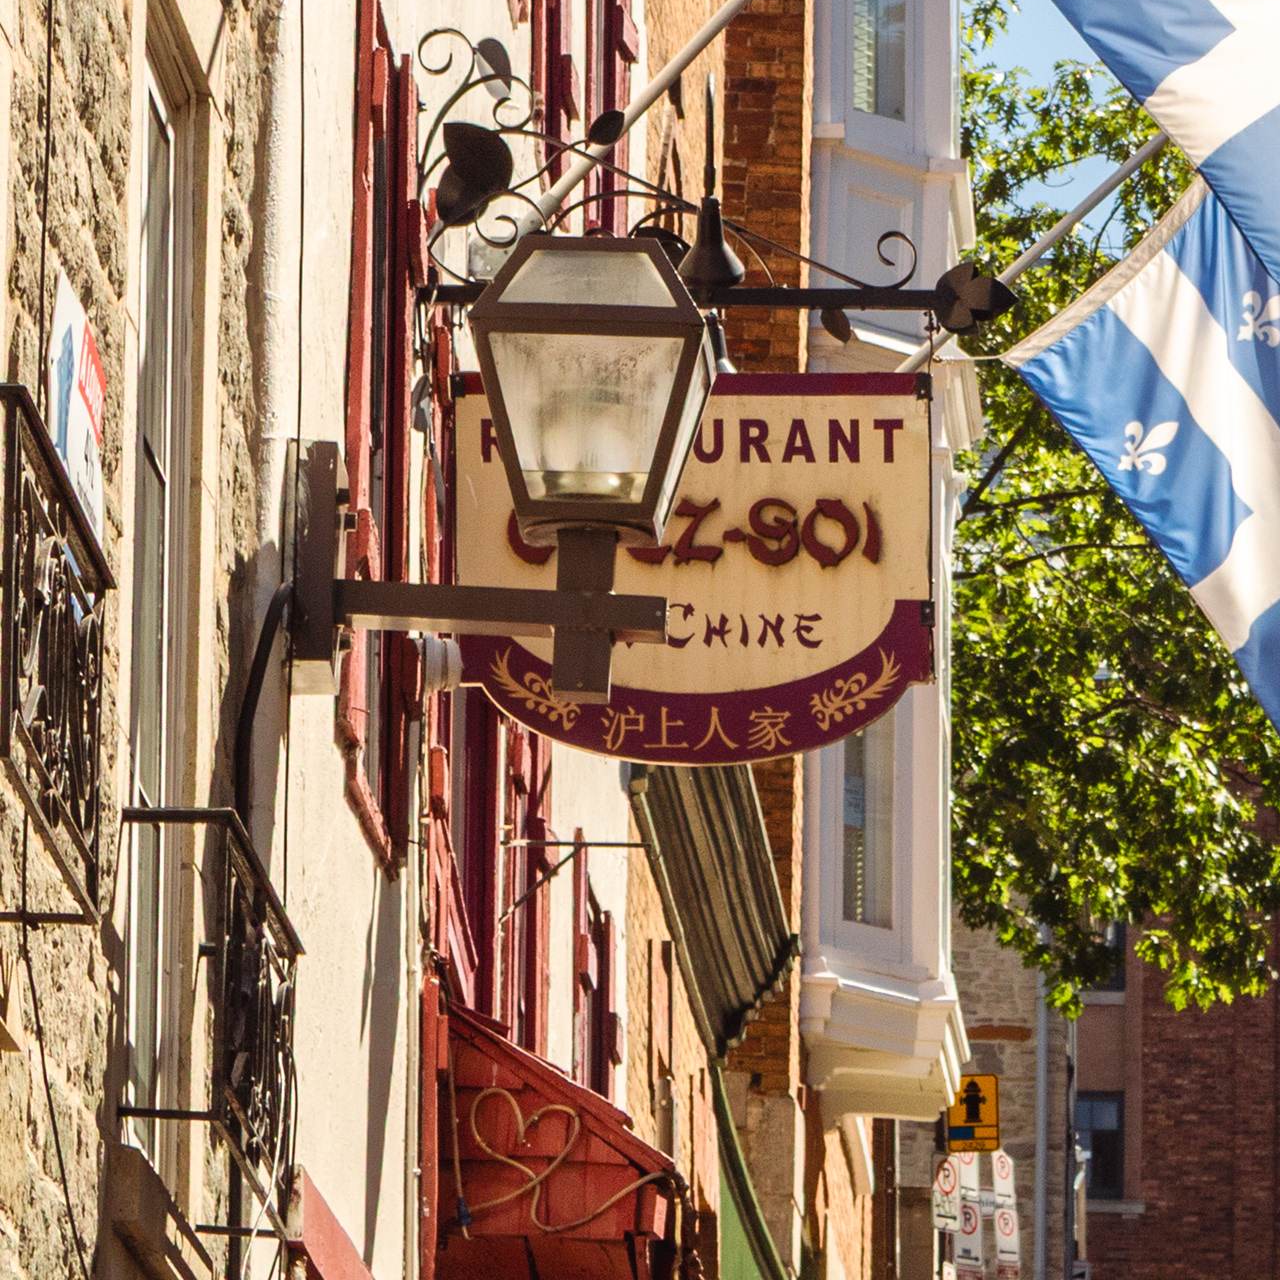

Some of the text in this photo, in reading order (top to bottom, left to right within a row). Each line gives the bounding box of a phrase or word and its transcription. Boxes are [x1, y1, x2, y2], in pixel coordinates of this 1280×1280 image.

[480, 418, 904, 464] RURANT
[600, 705, 793, 752] 沪上人家
